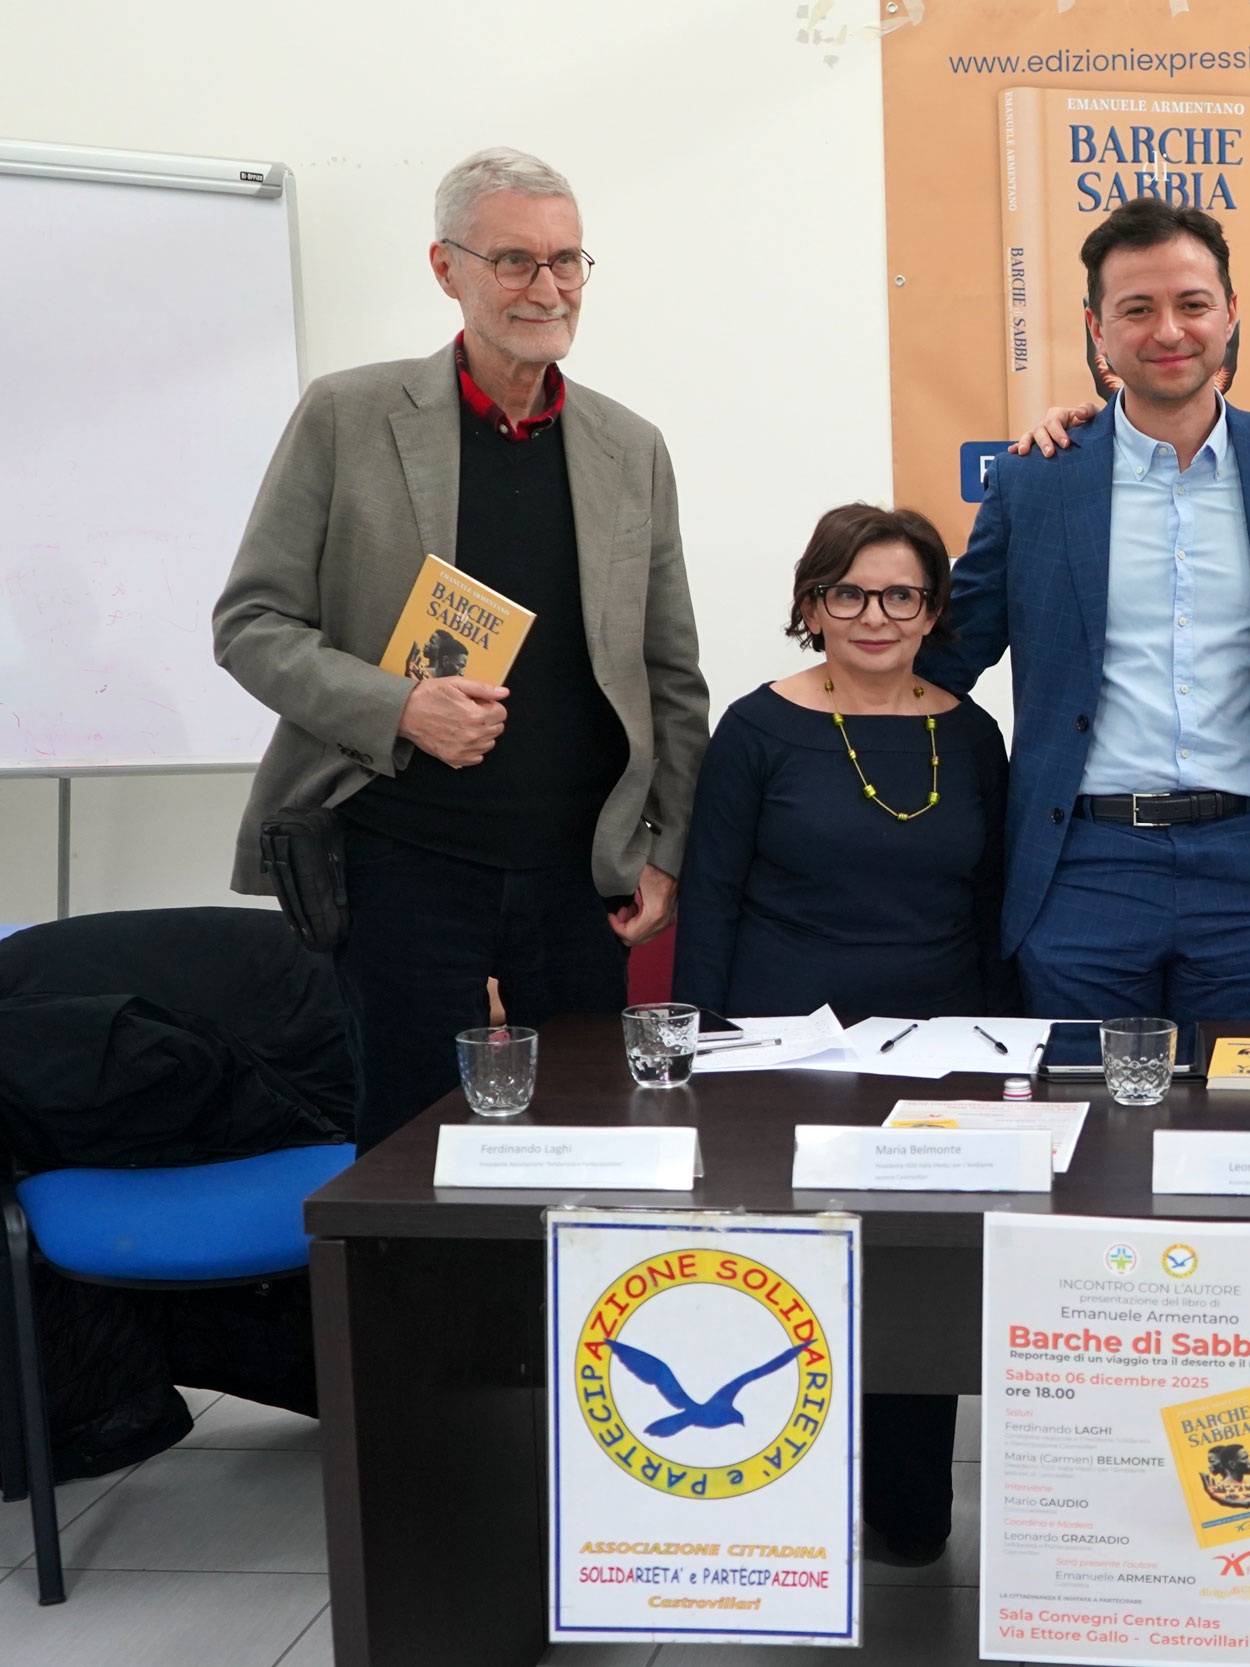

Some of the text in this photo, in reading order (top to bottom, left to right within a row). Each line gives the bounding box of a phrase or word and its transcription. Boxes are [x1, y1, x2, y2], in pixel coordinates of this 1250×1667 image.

[1066, 97, 1246, 115] EMANUELE ARMENTANO
[1069, 124, 1244, 166] BARCHE
[1142, 151, 1171, 183] di
[1077, 171, 1237, 212] SABBIA
[1011, 247, 1027, 306] BARCHE
[1014, 318, 1028, 372] SABBIA
[432, 582, 504, 635] BARCHE
[427, 600, 489, 650] SABBIA
[480, 1144, 572, 1156] Ferdinando Laghi
[876, 1144, 961, 1155] Maria Belmonte
[1061, 1306, 1239, 1325] Emanuele Armentano
[1009, 1325, 1122, 1352] Barche
[1132, 1331, 1161, 1354] di
[1006, 1369, 1209, 1388] Sabato 06 dicembre 2025
[1005, 1421, 1112, 1435] Ferdinando LAGHI
[1005, 1452, 1165, 1466] Maria (Carmen) BELMONTE
[1004, 1496, 1089, 1508] Mario GAUDIO
[1004, 1532, 1130, 1545] Leonardo GRAZIADIO
[579, 1541, 827, 1559] ASSOCIAZIONE CITTADINA
[690, 1573, 697, 1584] e
[703, 1566, 829, 1588] PARTECIPAZIONE
[1056, 1571, 1196, 1585] Emanuele ARMENTANO
[648, 1596, 762, 1610] Castrovillari
